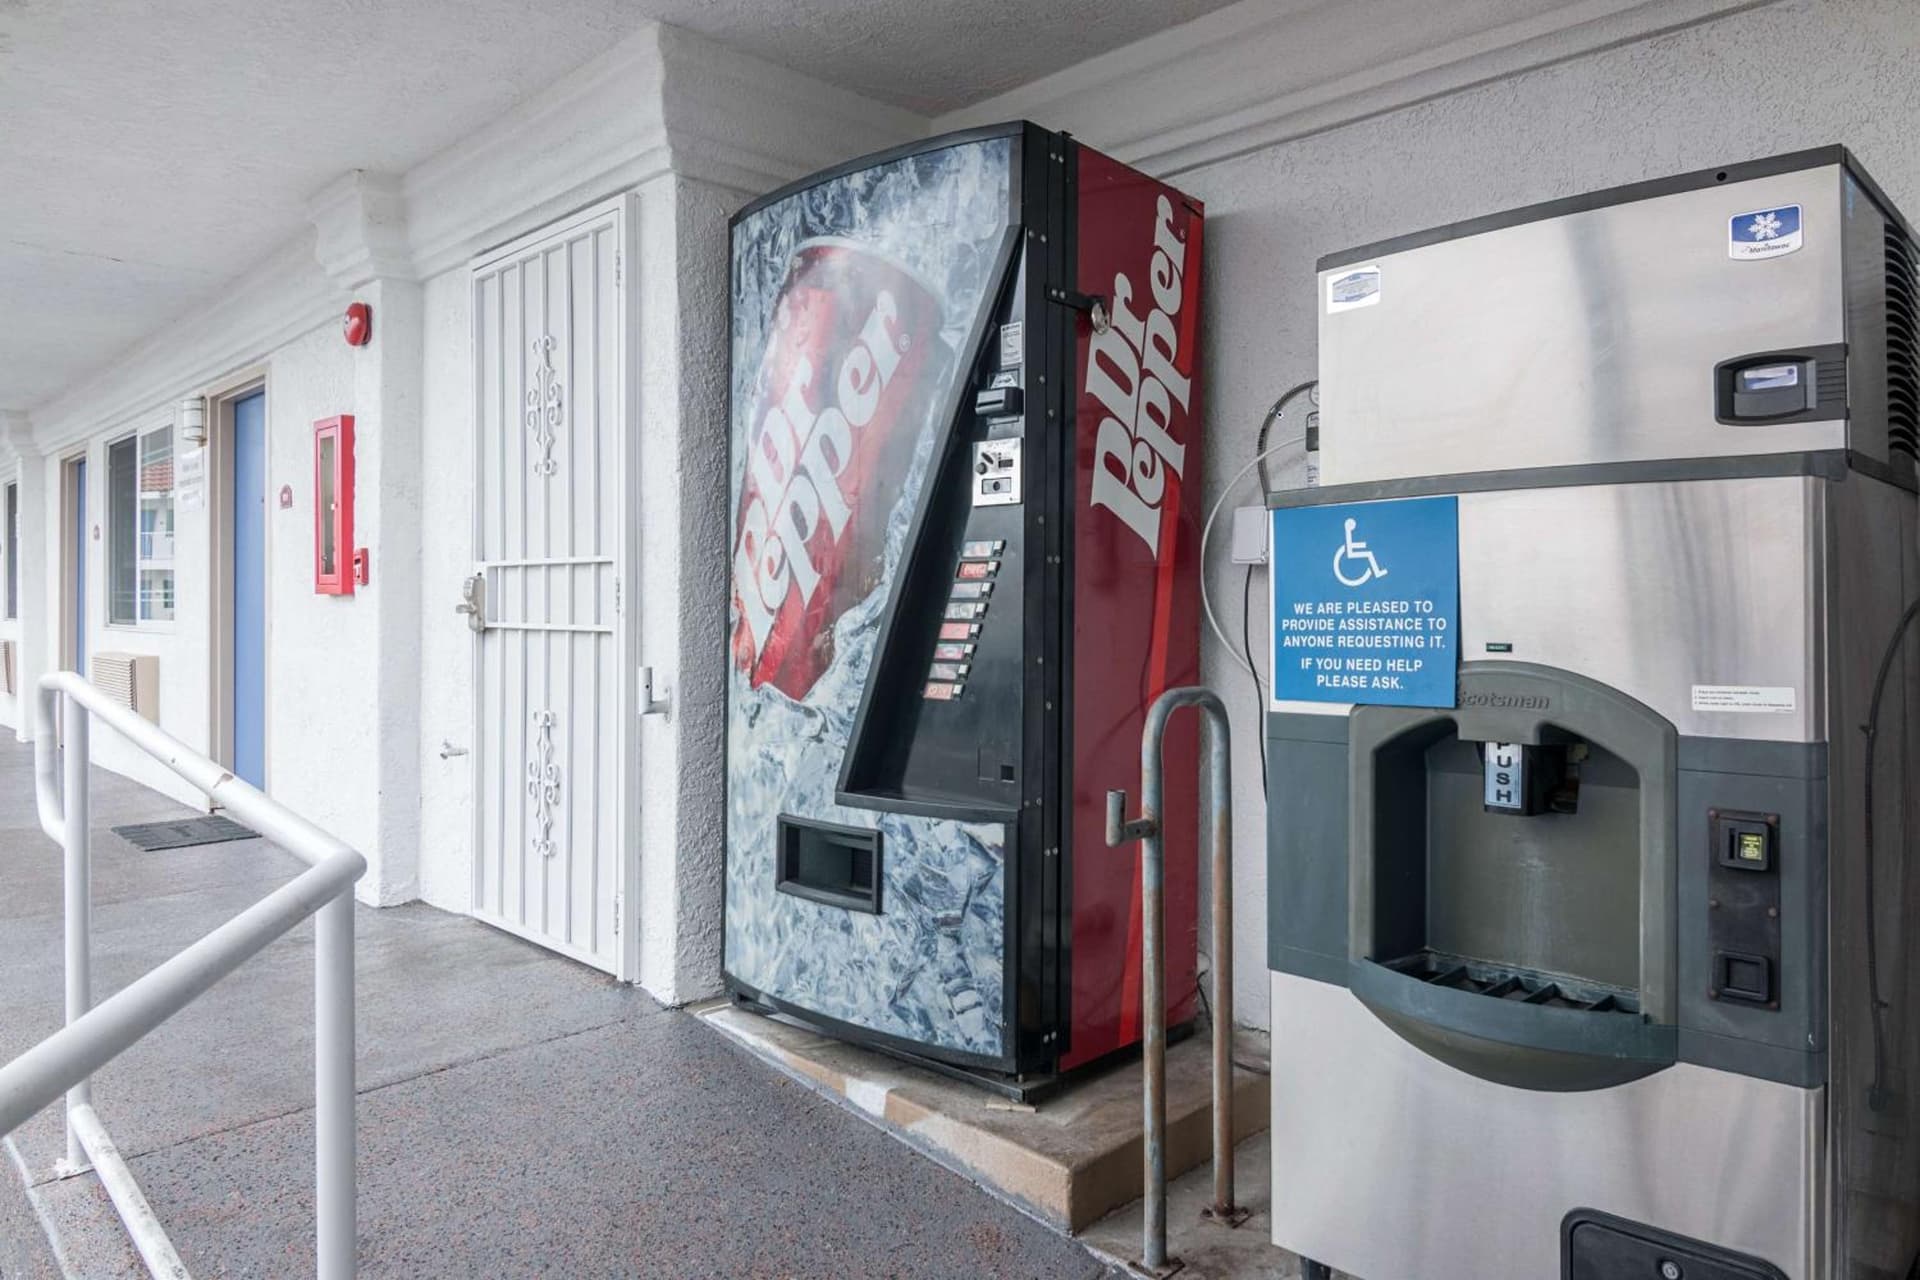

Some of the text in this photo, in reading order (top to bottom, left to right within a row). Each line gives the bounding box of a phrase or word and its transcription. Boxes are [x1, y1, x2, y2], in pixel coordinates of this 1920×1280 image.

[1085, 272, 1145, 438] Dr
[1090, 194, 1190, 560] Pepper
[751, 354, 816, 528] Dr
[735, 291, 901, 656] Pepper
[1282, 617, 1447, 631] PROVIDE ASSISTANCE TO
[1294, 600, 1433, 615] WE ARE PLEASED TO
[1283, 635, 1446, 648] ANYONE REQUESTING IT.
[1301, 658, 1423, 672] IF YOU NEED HELP
[1316, 675, 1404, 689] PLEASE ASK.
[1496, 742, 1512, 802] PUSH
